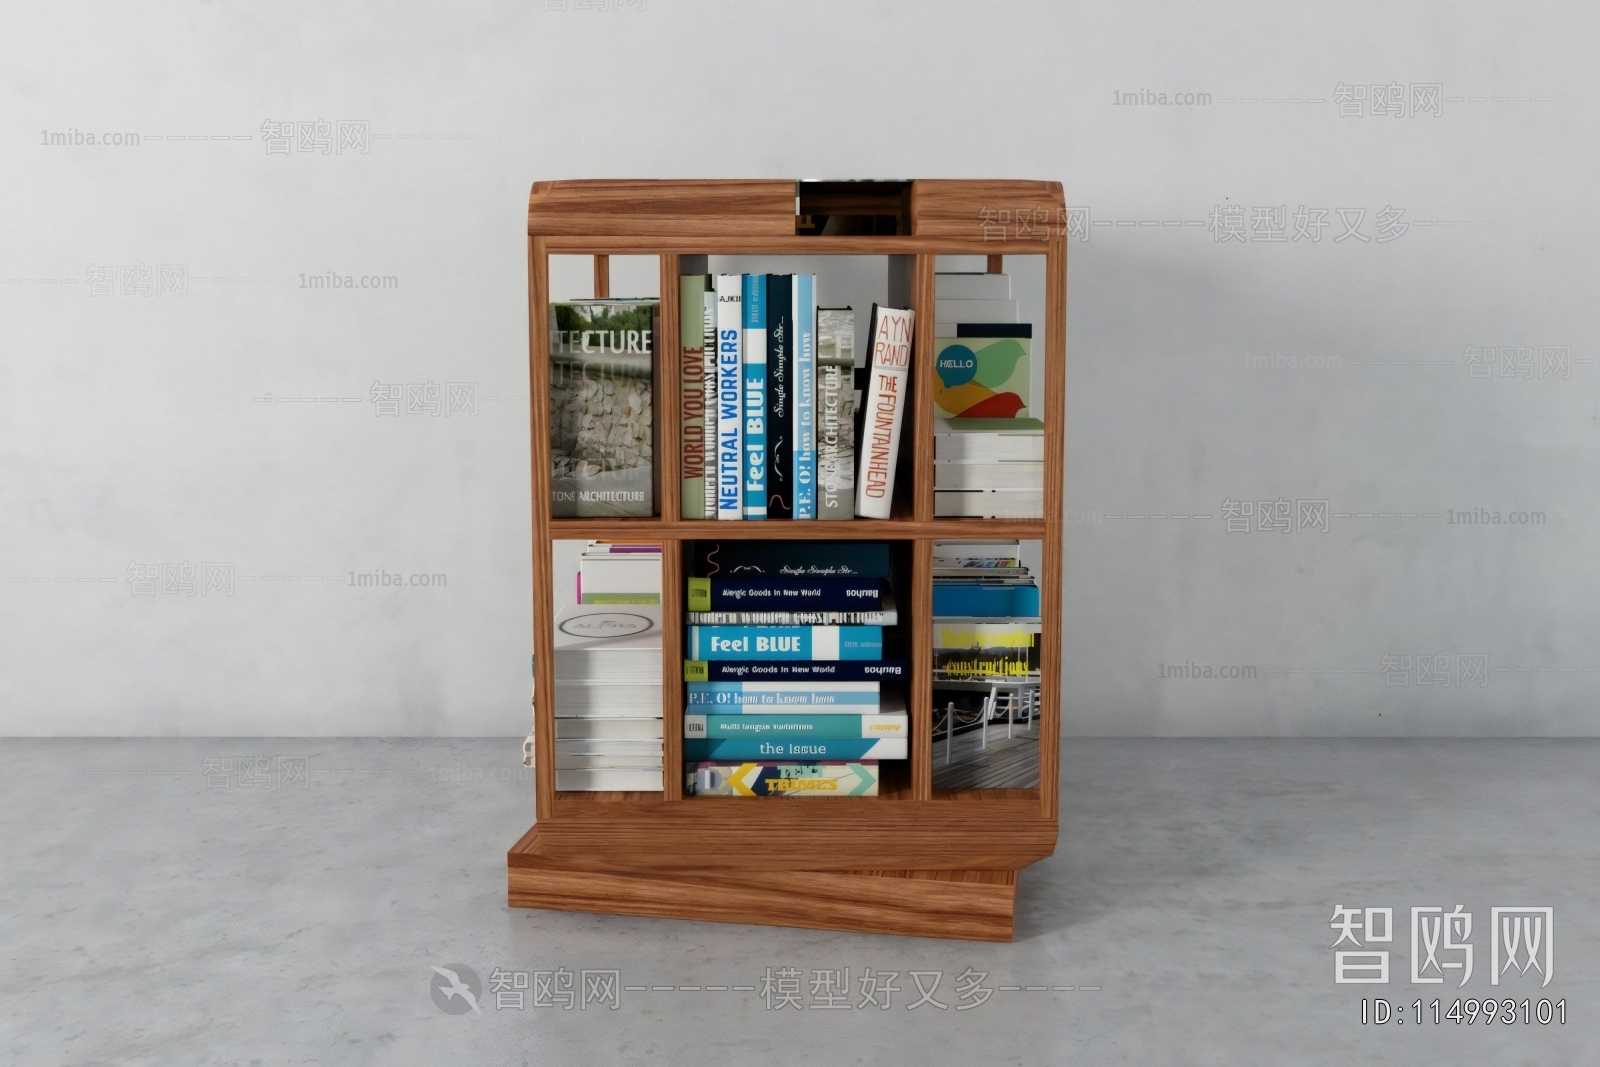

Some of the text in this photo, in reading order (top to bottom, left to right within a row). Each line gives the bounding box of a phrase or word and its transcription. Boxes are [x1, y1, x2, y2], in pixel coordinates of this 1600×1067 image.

[873, 343, 910, 367] RAND
[877, 316, 912, 342] AYN
[683, 346, 703, 479] WORLD YOU LOVE
[719, 329, 738, 510] NEUTRAL WORKERS
[747, 378, 764, 492] Feel BLUE
[865, 375, 898, 499] THE FOUNTAINHEAD
[711, 636, 801, 653] Feel BLUE
[759, 742, 784, 754] the
